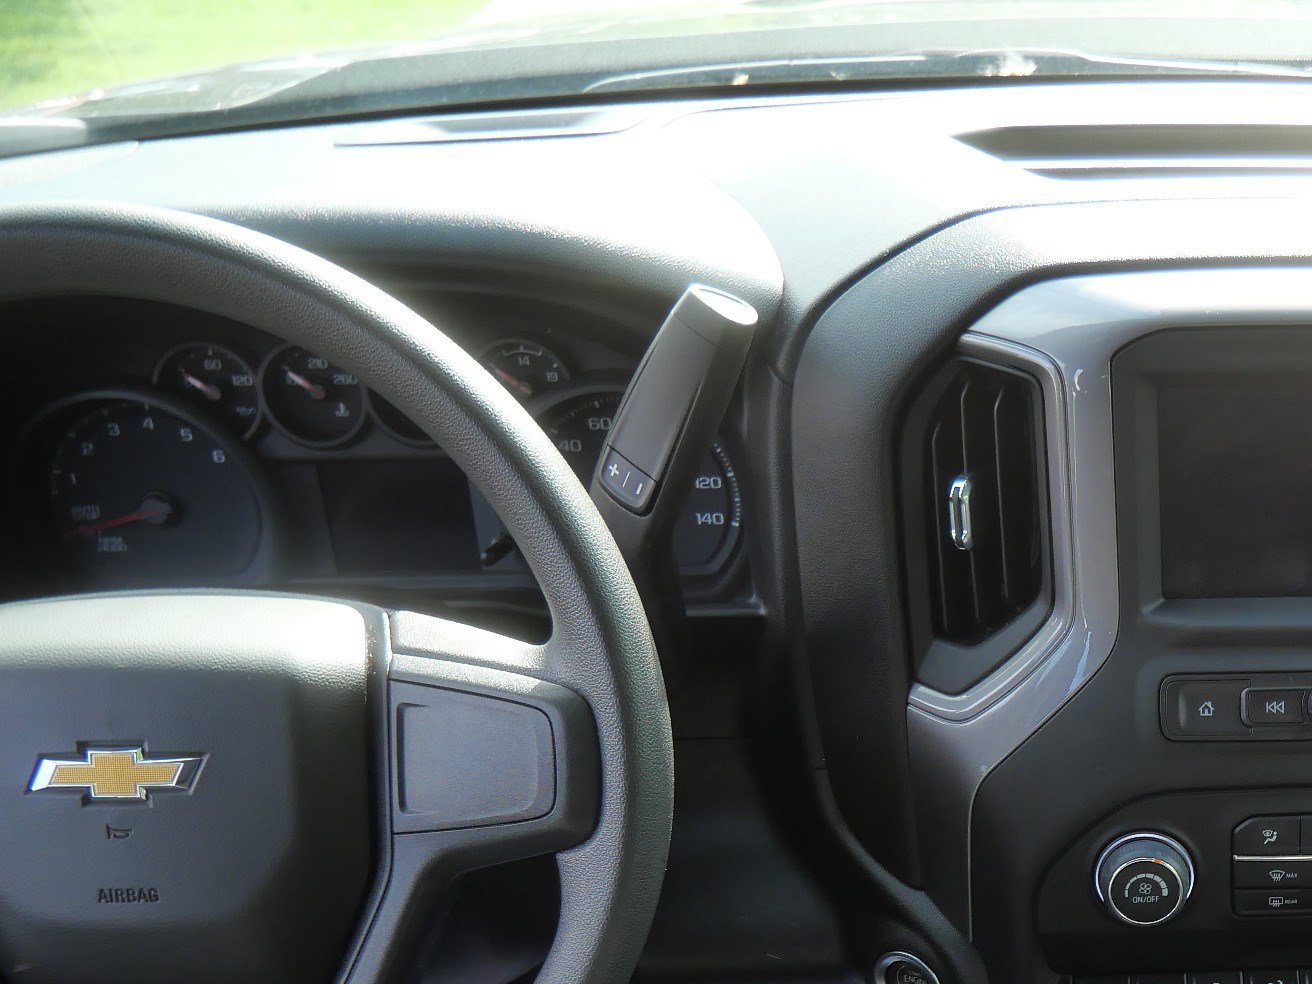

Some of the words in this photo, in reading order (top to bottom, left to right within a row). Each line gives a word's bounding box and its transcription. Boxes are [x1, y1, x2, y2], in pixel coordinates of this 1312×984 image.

[518, 355, 530, 366] 14
[142, 417, 155, 430] 4
[588, 417, 612, 431] 60
[694, 476, 722, 489] 120
[694, 513, 724, 526] 140
[97, 887, 160, 903] AIRBAG
[1132, 895, 1160, 904] ON/OFF
